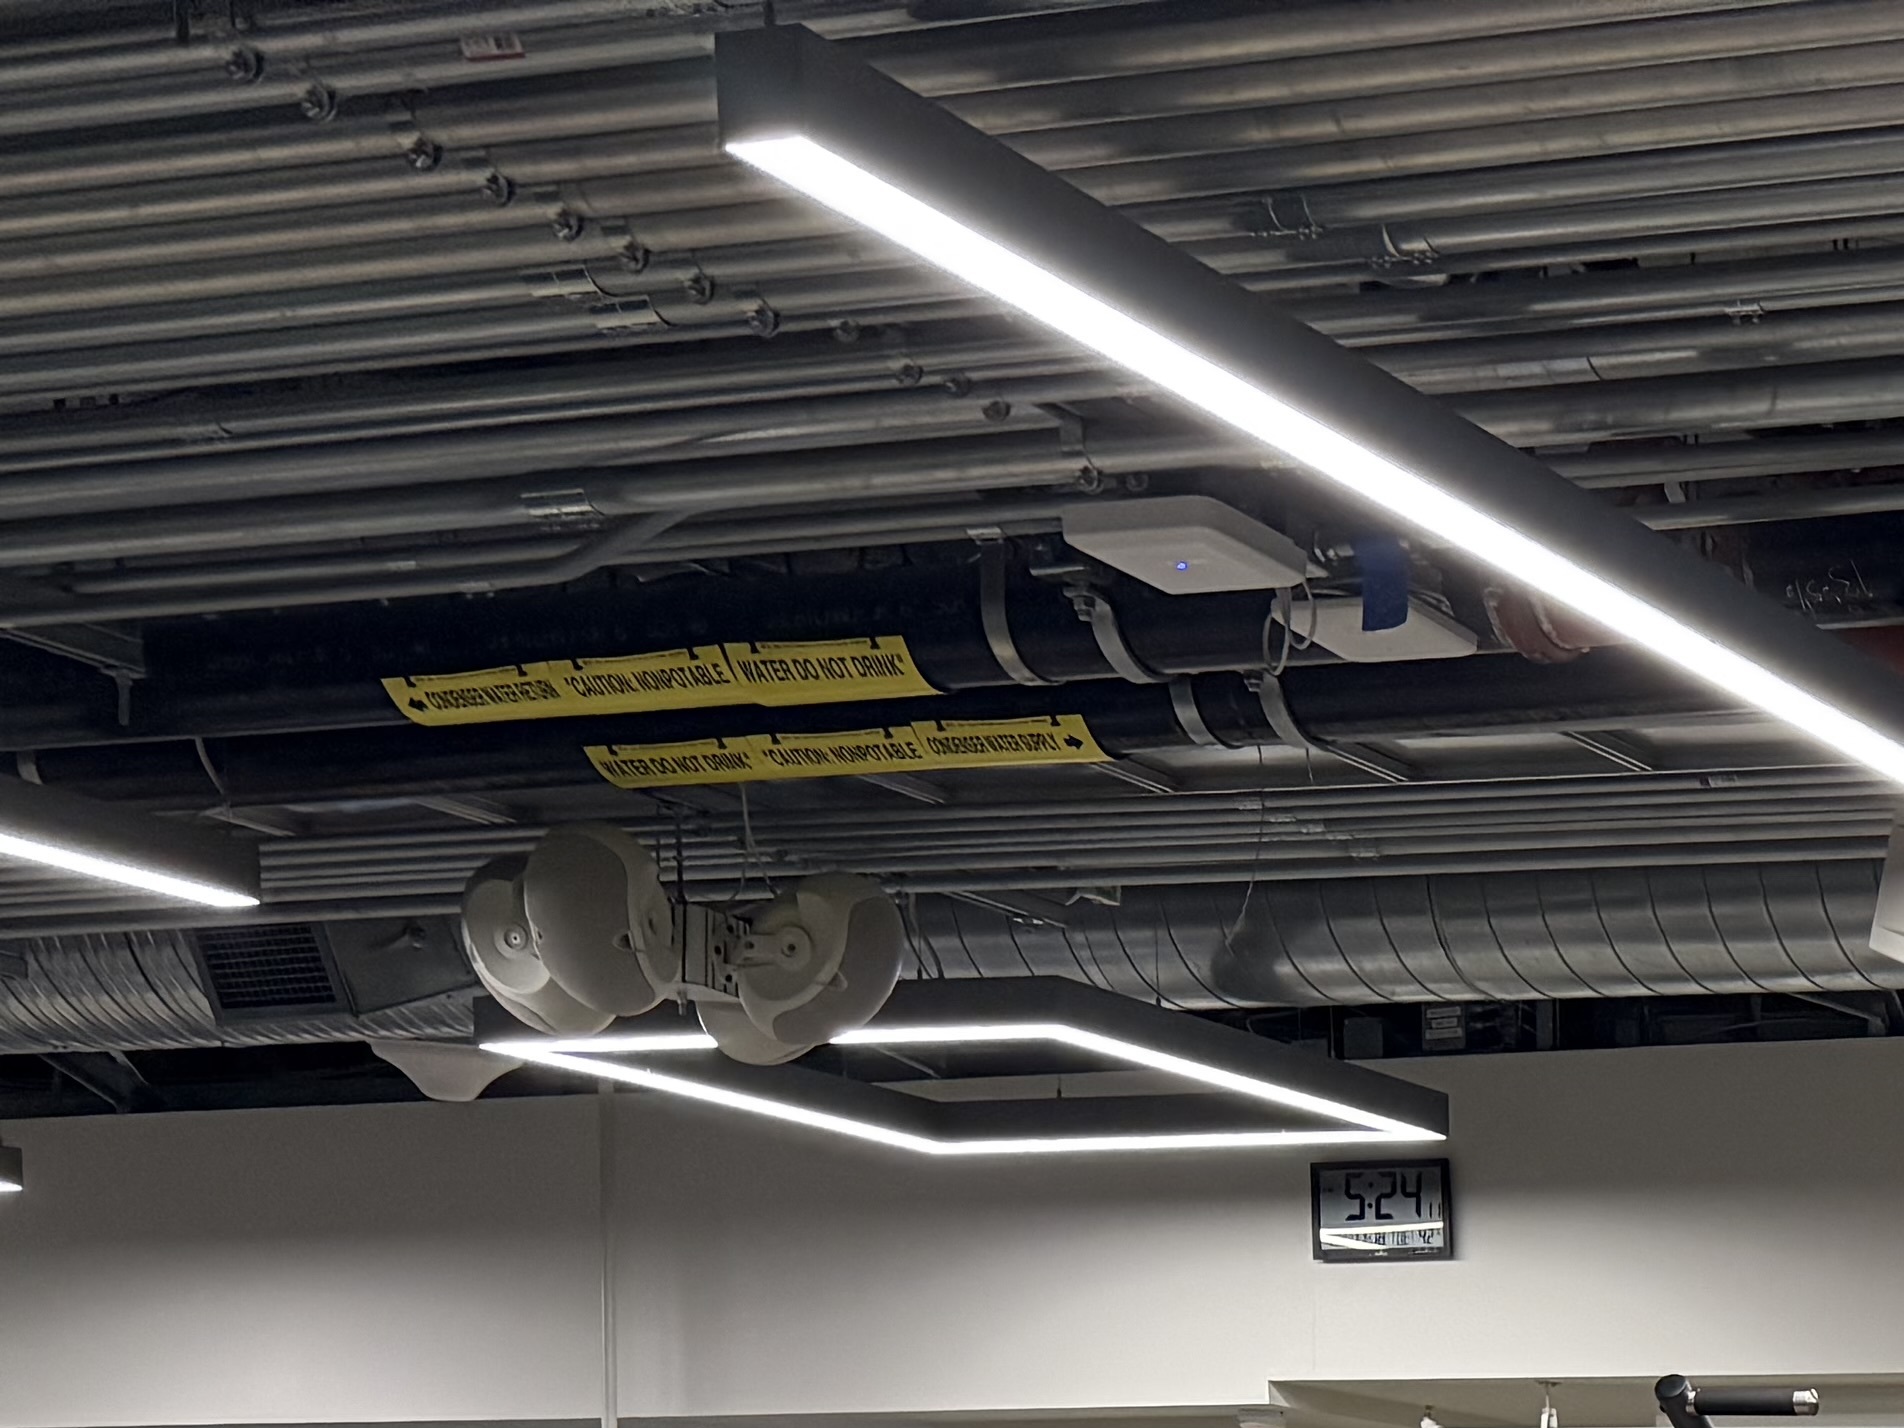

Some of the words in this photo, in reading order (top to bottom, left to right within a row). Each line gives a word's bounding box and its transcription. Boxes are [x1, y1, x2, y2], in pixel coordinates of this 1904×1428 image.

[483, 683, 517, 707] WATER
[634, 662, 731, 692] NONPOTABLE
[737, 659, 795, 684] WATER
[791, 657, 821, 681] DO
[822, 656, 856, 680] NOT
[600, 758, 650, 778] WATER
[648, 756, 675, 776] DO
[676, 754, 707, 774] NOT
[834, 741, 923, 766] NONPOTABLE
[985, 733, 1023, 754] WATER
[1344, 1171, 1423, 1222] 5:24
